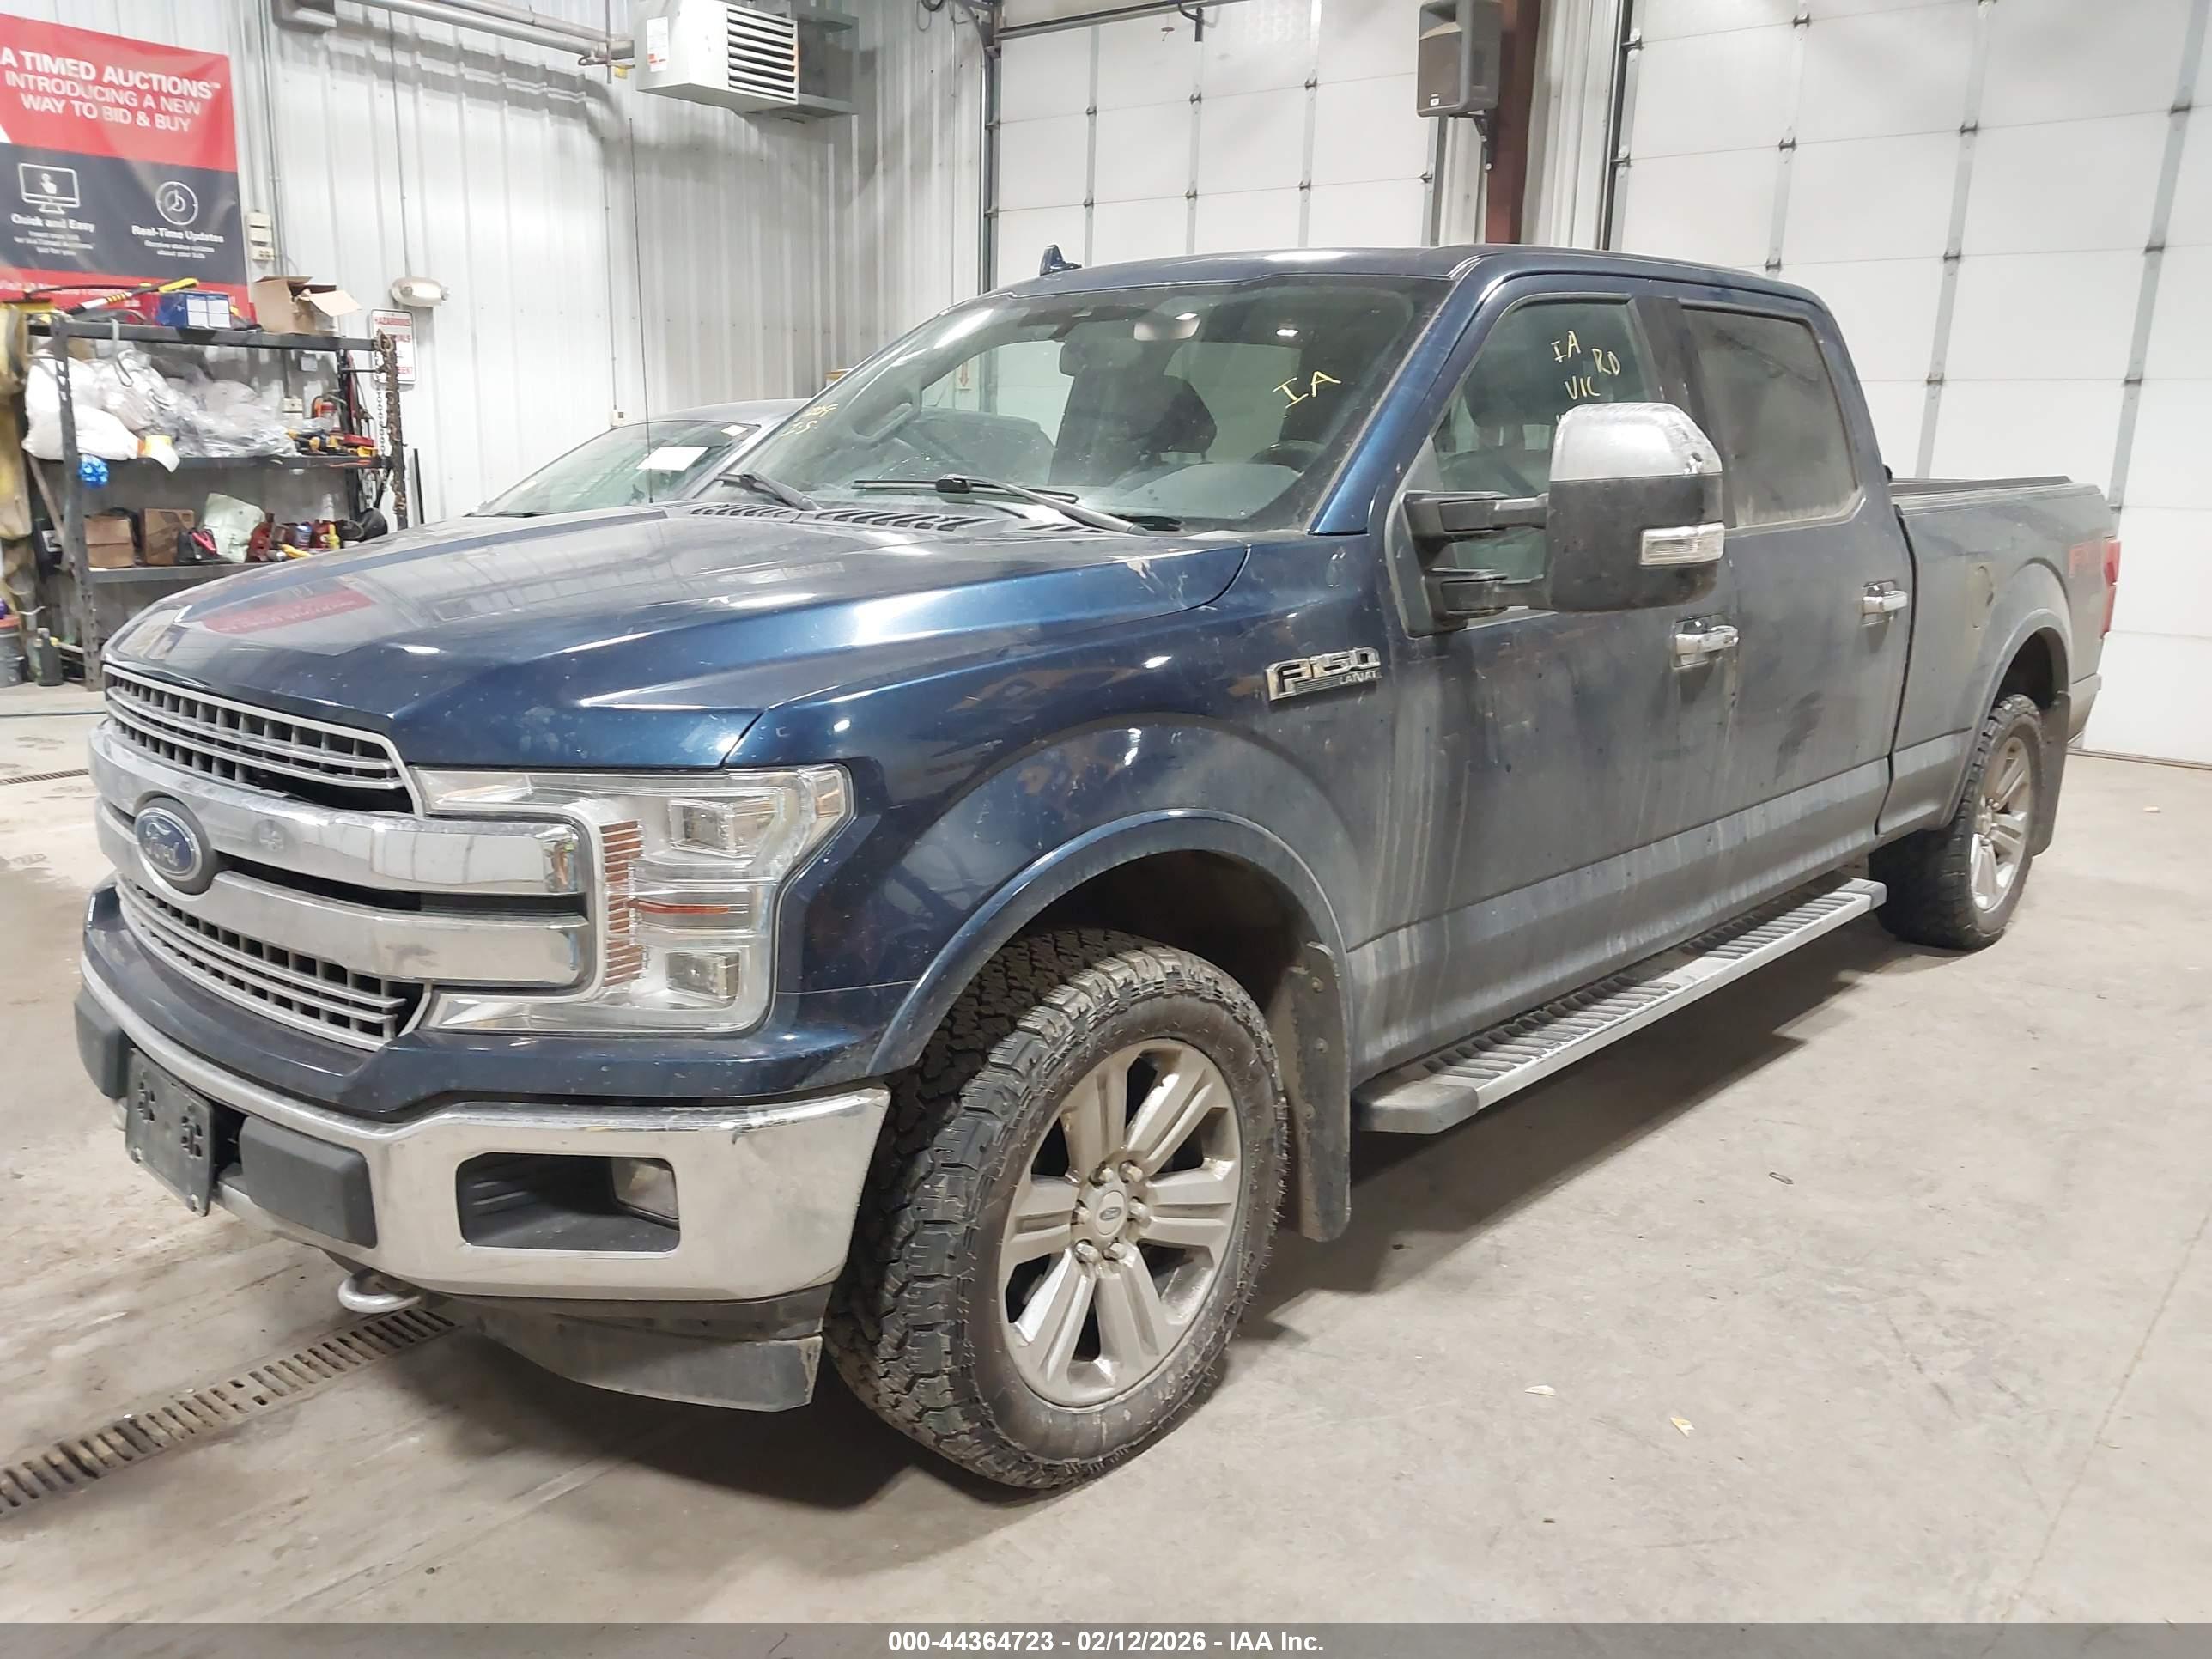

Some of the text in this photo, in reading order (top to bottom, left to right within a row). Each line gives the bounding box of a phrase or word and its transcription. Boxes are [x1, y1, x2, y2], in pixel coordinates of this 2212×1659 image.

[19, 50, 96, 81] TIMED
[5, 70, 201, 116] INTRODUCING A NEW
[20, 93, 191, 132] WAY TO BID & BUY
[1272, 371, 1342, 409] IA
